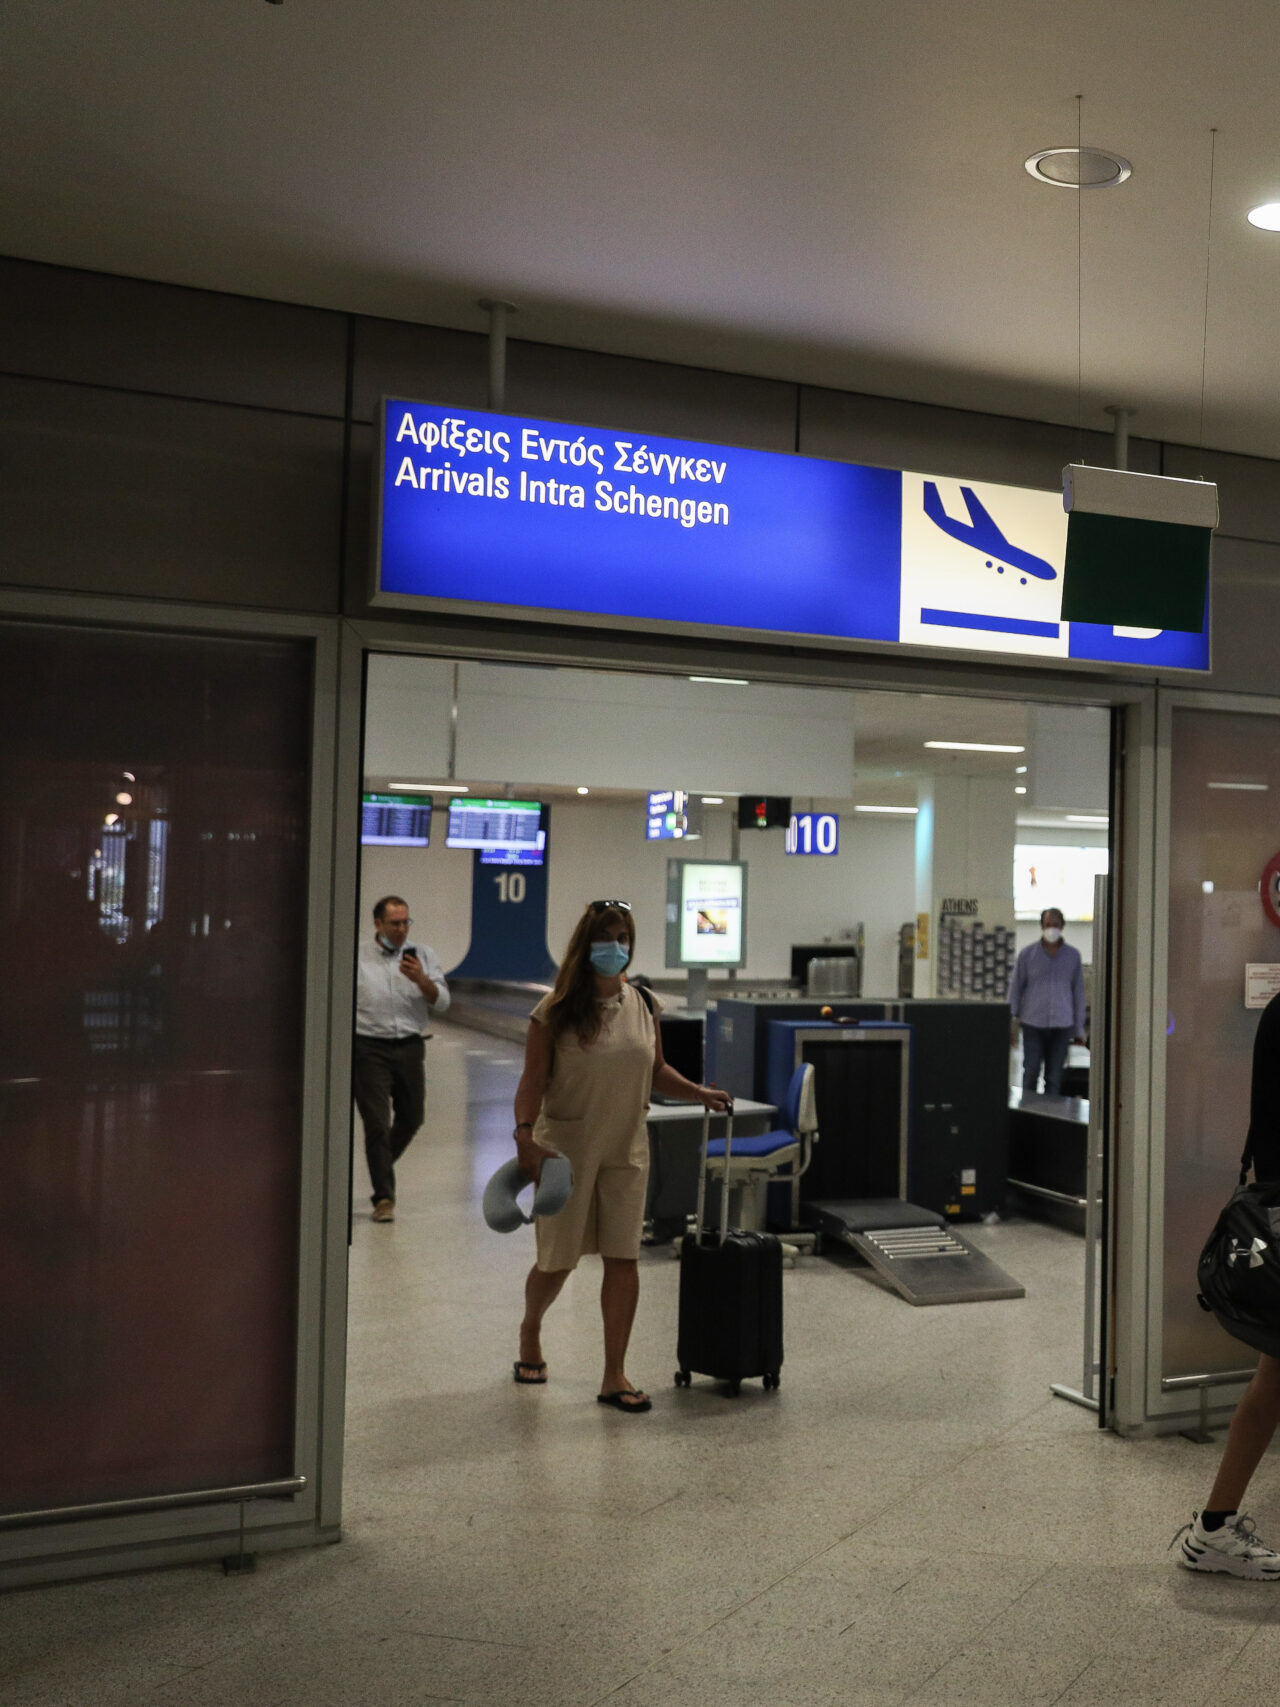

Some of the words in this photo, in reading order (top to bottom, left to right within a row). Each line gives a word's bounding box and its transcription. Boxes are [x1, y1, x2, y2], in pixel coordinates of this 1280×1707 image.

[396, 412, 510, 463] Αφίξεις
[521, 429, 605, 474] Εντός
[613, 442, 727, 484] Σένγκεν
[394, 456, 510, 500] Arrivals
[520, 471, 585, 508] Intra
[595, 481, 729, 528] Schengen
[799, 815, 837, 854] 10
[494, 872, 526, 903] 10
[942, 898, 979, 914] ATHENS
